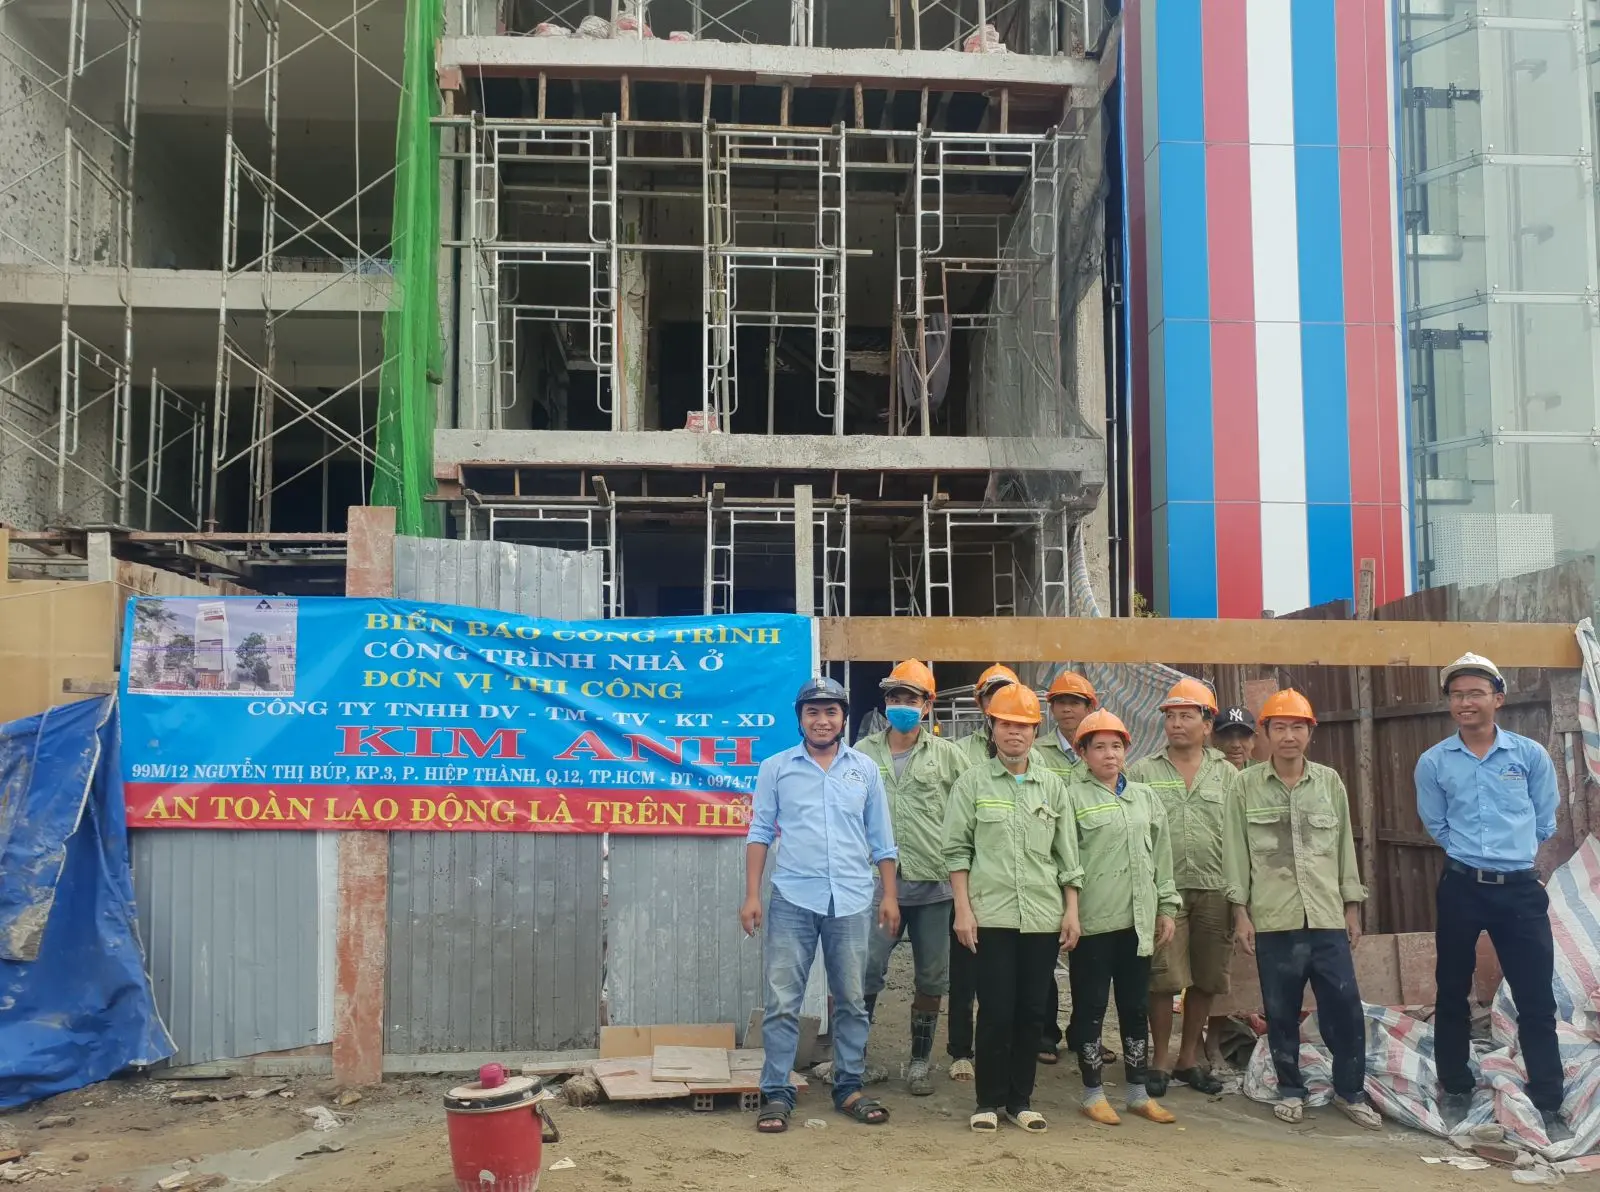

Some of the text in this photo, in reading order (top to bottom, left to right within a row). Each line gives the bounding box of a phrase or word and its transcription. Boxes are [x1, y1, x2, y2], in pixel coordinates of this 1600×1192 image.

[364, 609, 782, 644] BIỂN BÁO CÔNG TRÌNH
[364, 637, 725, 672] CÔNG TRÌNH NHÀ Ở
[362, 668, 685, 700] ĐƠN VỊ THI CÔNG
[247, 697, 328, 717] CÔNG
[338, 702, 378, 717] TY
[384, 702, 468, 718] TNHH
[479, 704, 520, 720] DV
[545, 706, 587, 722] TM
[612, 711, 651, 727] TV
[675, 712, 713, 727] KT
[737, 713, 776, 728] XD
[335, 725, 760, 766] KIM ANH
[132, 763, 189, 779] 99M/12
[194, 757, 267, 780] NGUYỄN
[272, 764, 303, 783] THỊ
[310, 760, 350, 783] BÚP,
[355, 765, 397, 784] KP.3,
[403, 766, 418, 781] P.
[424, 763, 468, 785] HIỆP
[474, 763, 541, 785] THÀNH,
[545, 768, 583, 787] Q.12,
[589, 769, 655, 785] TP.HCM
[144, 796, 199, 820] AN
[210, 790, 314, 822] TOÀN
[324, 798, 399, 821] LAO
[409, 793, 516, 828] ĐỘNG
[527, 794, 575, 824] LÀ
[587, 796, 687, 826] TRÊN
